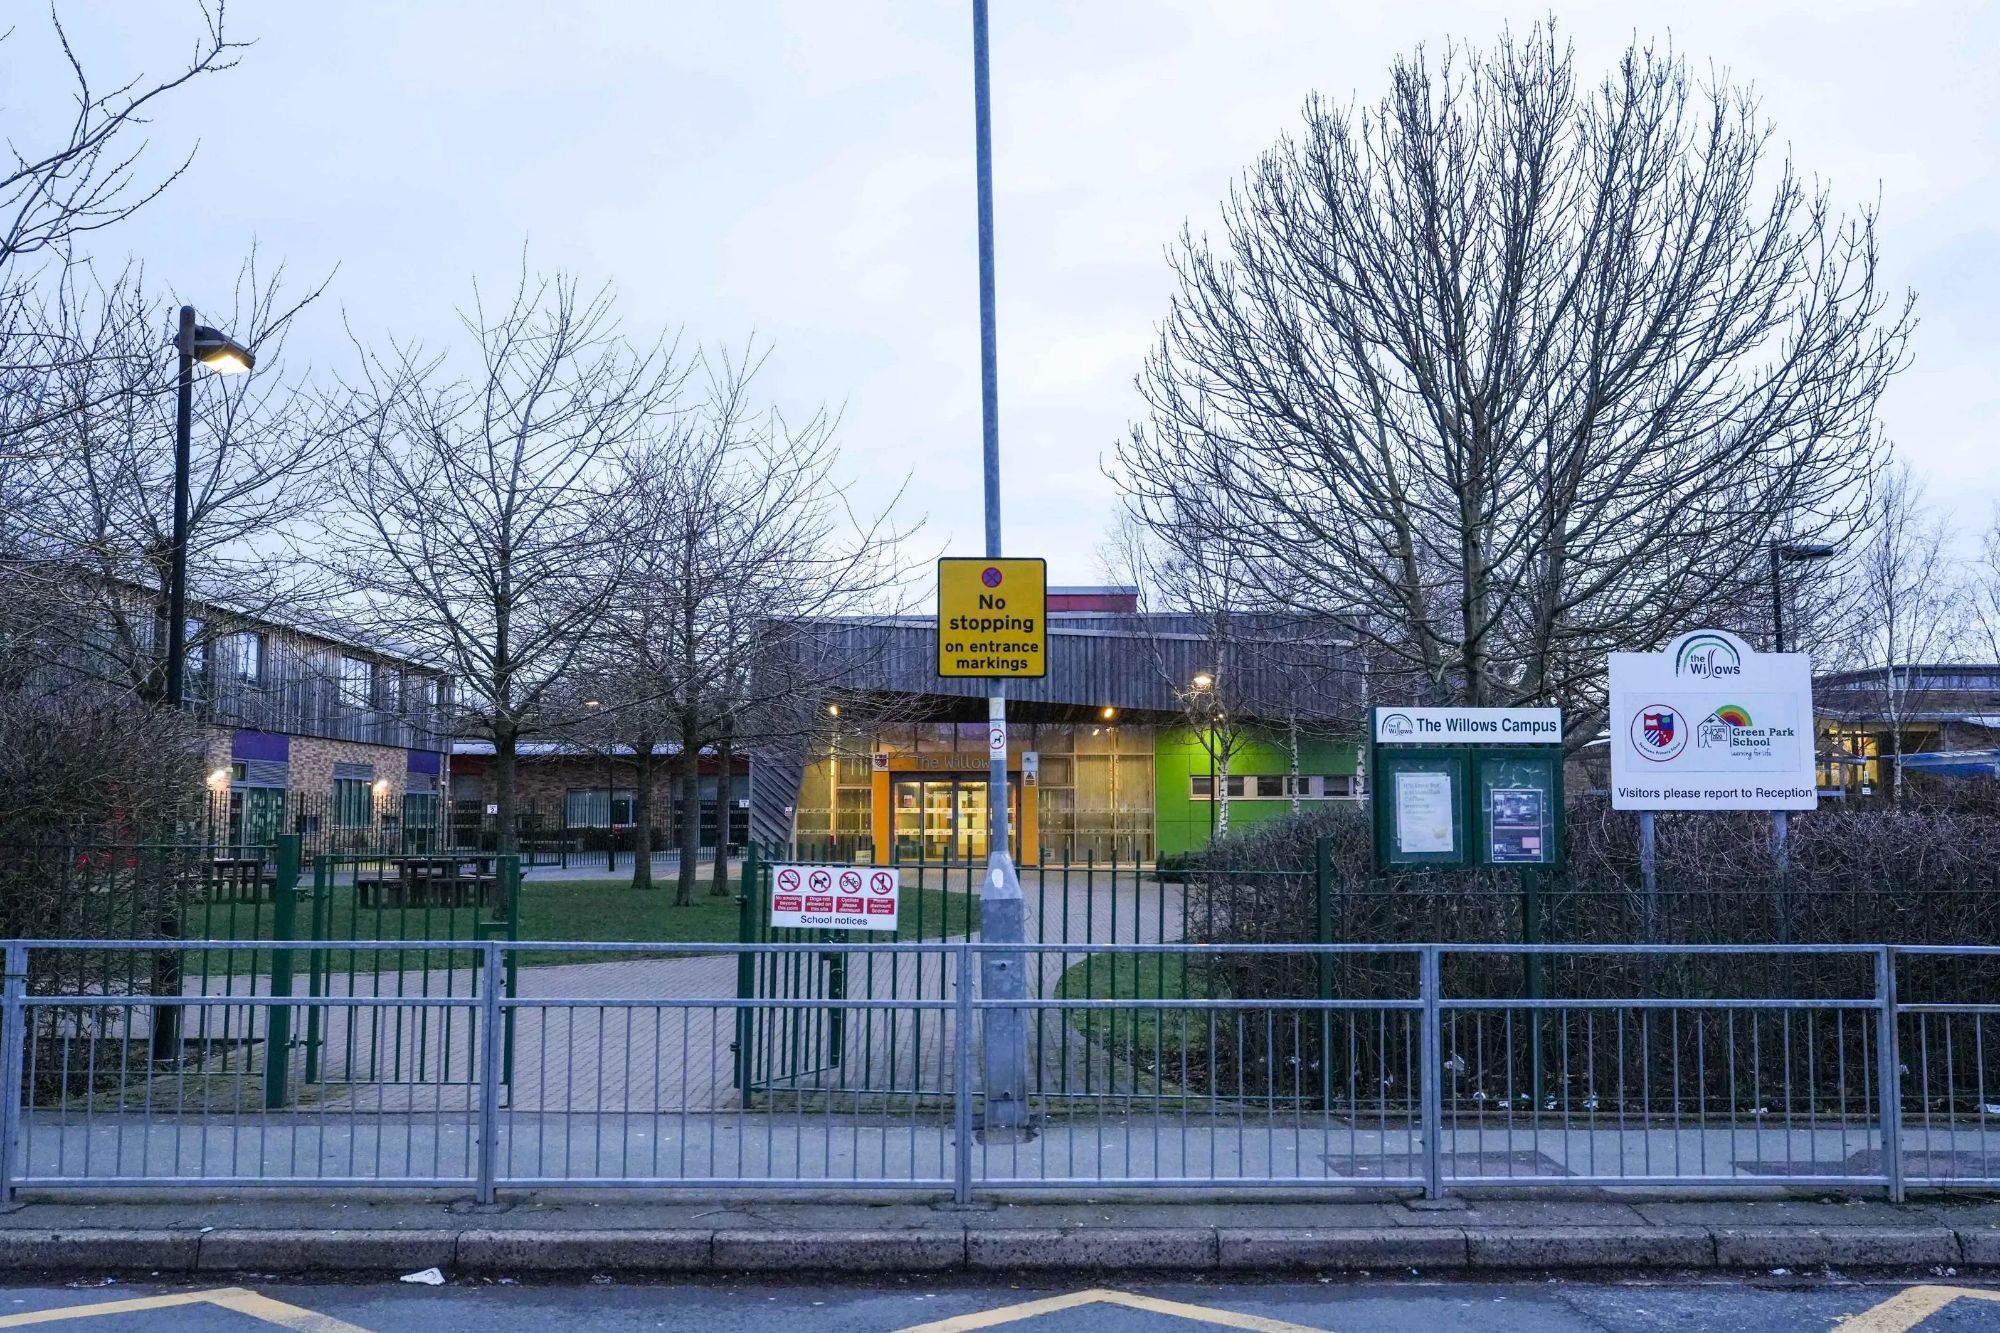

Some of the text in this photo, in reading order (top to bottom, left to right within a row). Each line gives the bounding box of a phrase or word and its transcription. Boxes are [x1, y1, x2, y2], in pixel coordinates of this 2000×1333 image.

[979, 594, 1006, 609] No
[950, 616, 1034, 633] stopping
[945, 641, 1038, 652] on entrance
[956, 657, 1028, 671] markings
[1690, 654, 1705, 662] the
[1690, 648, 1740, 679] Willows
[1416, 718, 1557, 736] The Willows Campus
[1732, 728, 1794, 736] Green Park
[1733, 738, 1770, 746] School
[944, 754, 990, 768] Willow
[1618, 787, 1813, 803] Visitors please report to Reception
[800, 915, 868, 926] School notices
